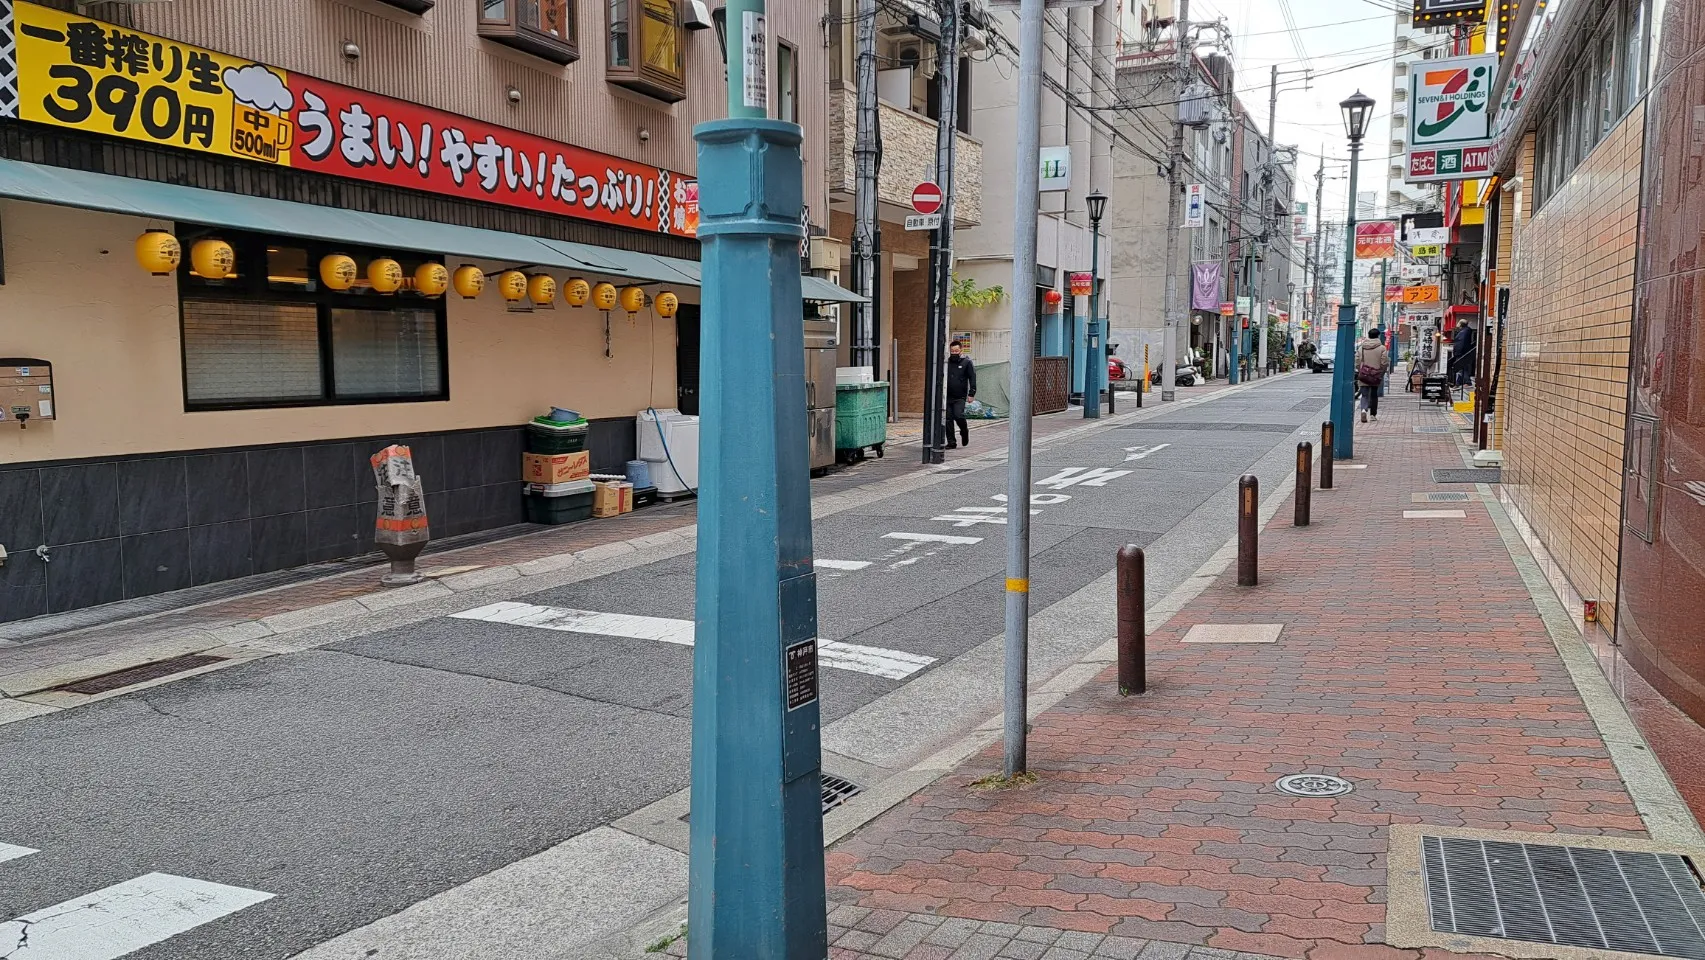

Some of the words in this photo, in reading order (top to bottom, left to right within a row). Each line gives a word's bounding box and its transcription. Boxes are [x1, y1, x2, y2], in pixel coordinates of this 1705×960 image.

[20, 22, 223, 95] 一番搾り生
[1450, 91, 1486, 101] HOLDINGS
[43, 65, 216, 148] 390円
[243, 111, 269, 131] 中
[234, 130, 278, 160] 500ml
[1411, 156, 1435, 171] たばこ
[1441, 154, 1457, 170] 酒
[1464, 151, 1487, 168] ATM
[907, 219, 924, 227] 自動車
[928, 217, 940, 226] 原付
[1357, 236, 1392, 244] 元町北通
[1410, 292, 1433, 300] アン
